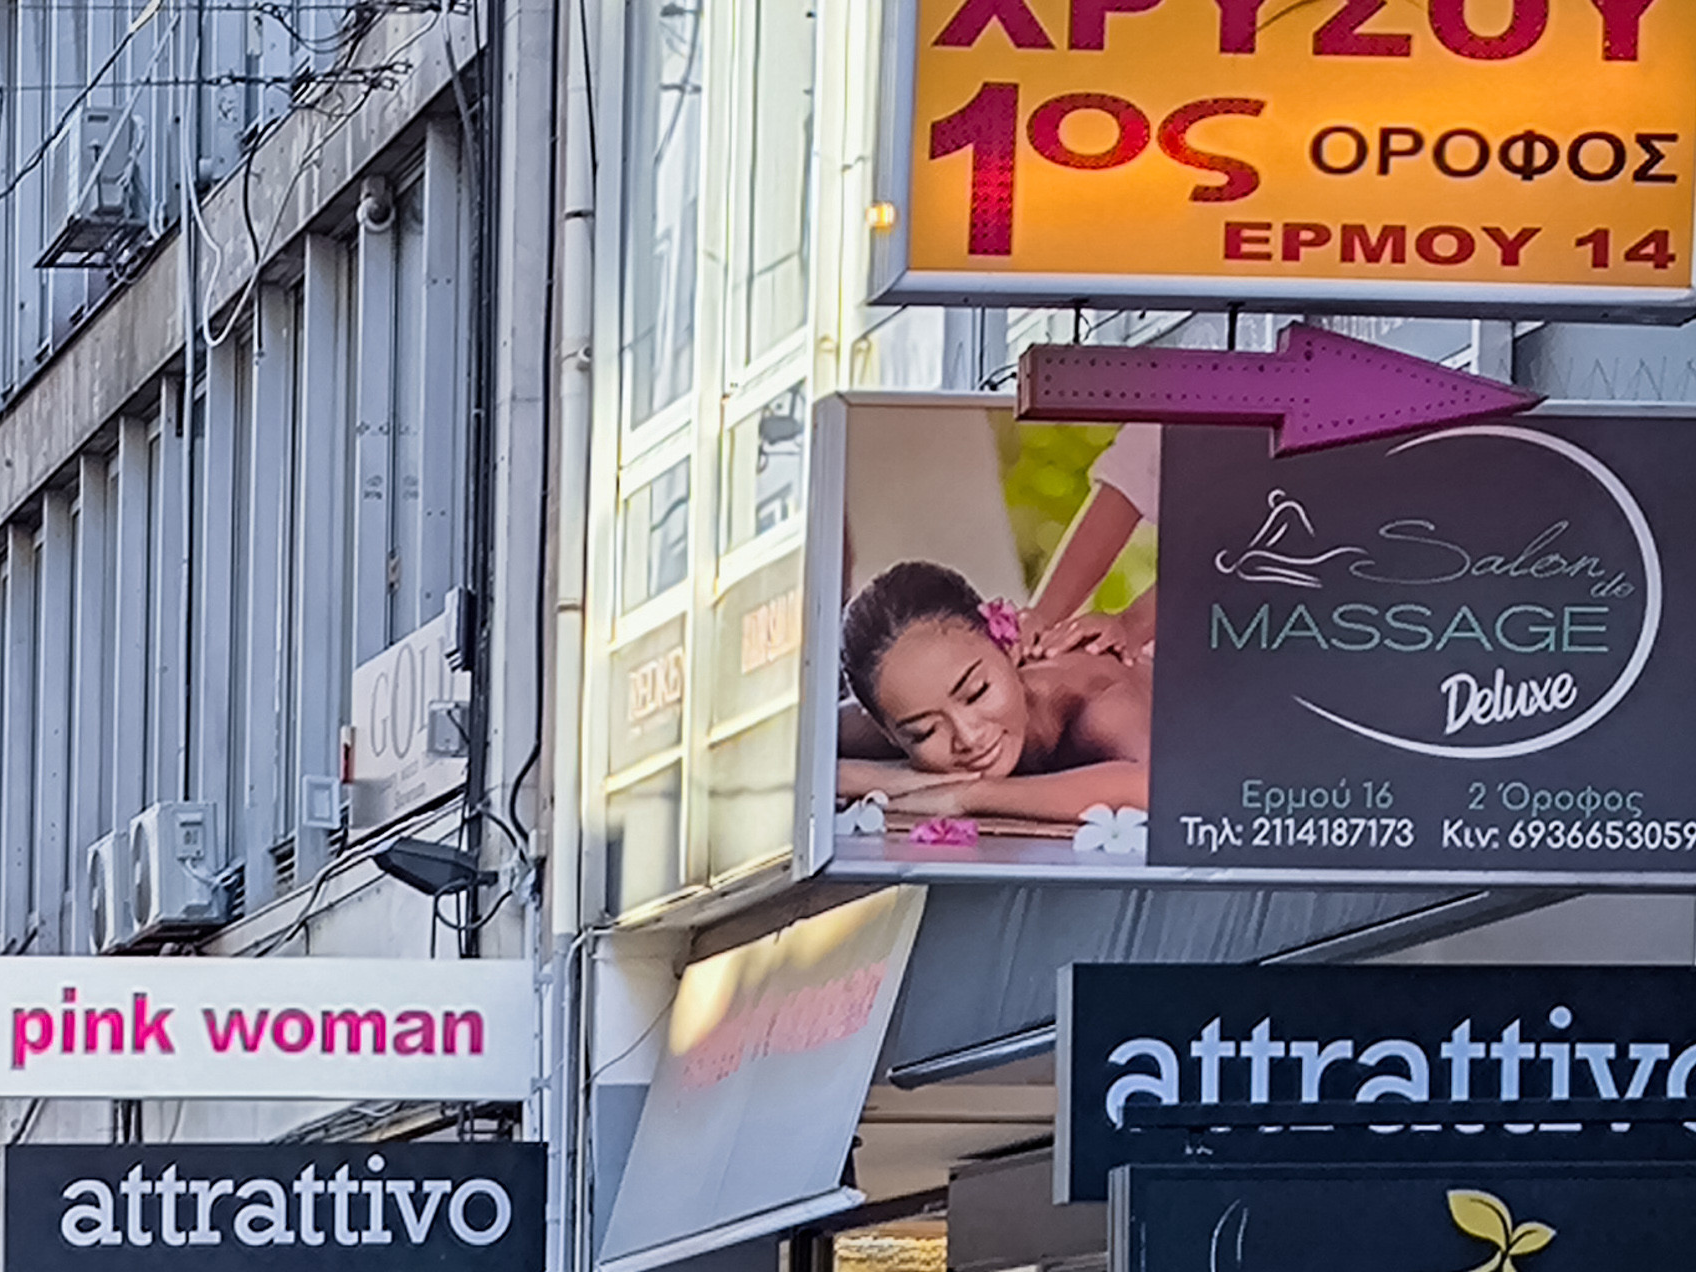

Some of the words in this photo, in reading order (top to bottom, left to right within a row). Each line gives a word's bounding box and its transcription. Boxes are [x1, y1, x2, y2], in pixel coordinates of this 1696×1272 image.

[1310, 126, 1679, 183] ΟΡΟΦΟΣ
[1223, 221, 1541, 267] ΕΡΜΟΥ
[1575, 229, 1676, 270] 14
[1349, 519, 1604, 584] Salon
[1210, 603, 1609, 652] MASSAGE
[1441, 668, 1578, 735] Deluxe
[1242, 778, 1351, 814] Ερμού
[1363, 781, 1394, 809] 16
[1469, 782, 1486, 810] 2
[1180, 816, 1244, 854] Τηλ:
[1252, 818, 1415, 847] 2114187173
[1442, 819, 1499, 850] Κιν:
[1508, 819, 1696, 849] 6936653059
[11, 986, 176, 1069] pink
[205, 1007, 485, 1056] woman
[60, 1153, 513, 1247] attrattivo
